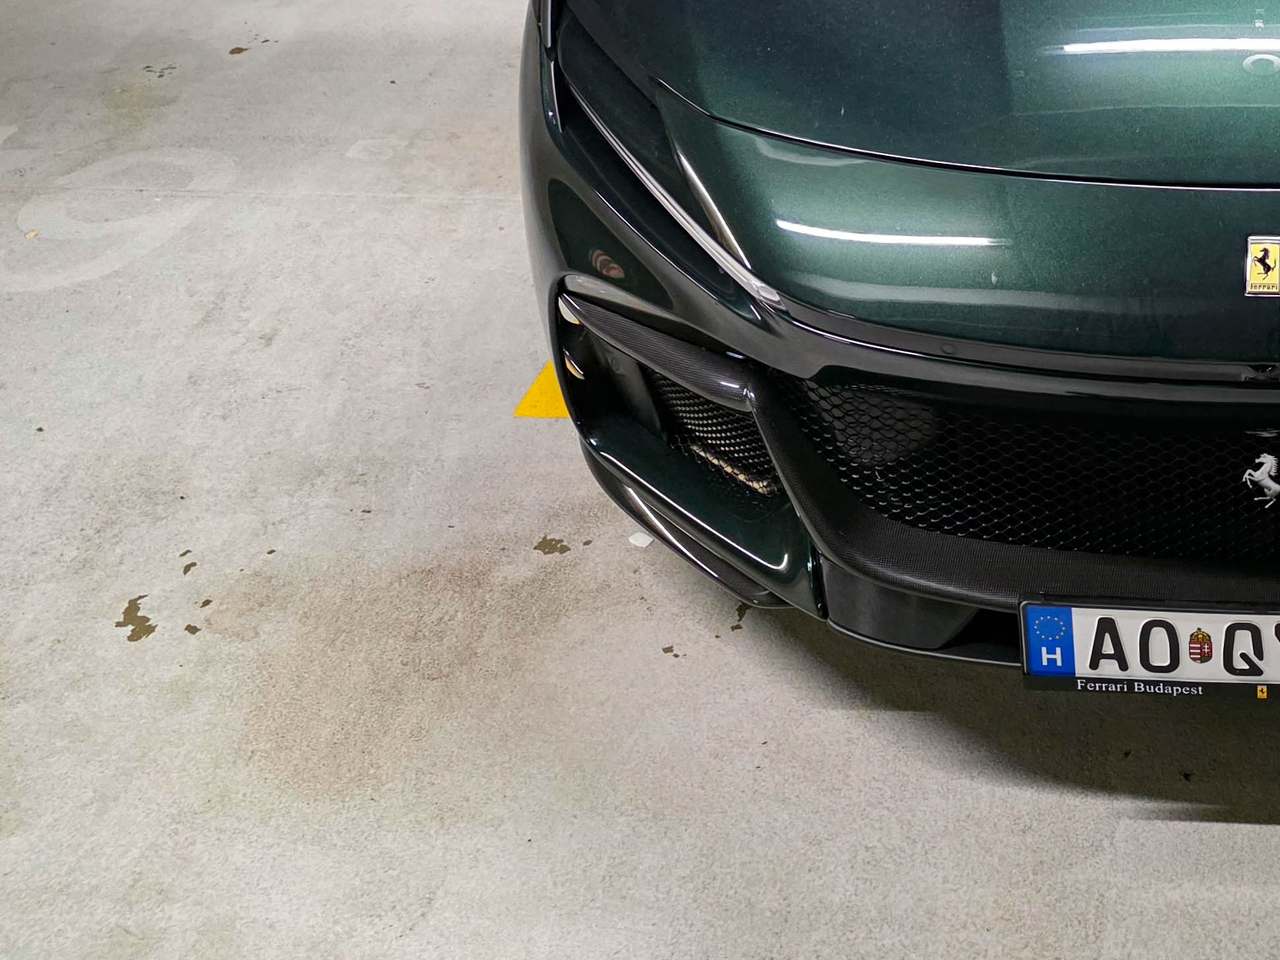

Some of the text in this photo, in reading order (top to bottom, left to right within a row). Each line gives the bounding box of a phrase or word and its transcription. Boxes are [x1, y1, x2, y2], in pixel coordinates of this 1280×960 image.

[1041, 646, 1062, 667] H
[1076, 679, 1204, 696] Ferrari Budapest
